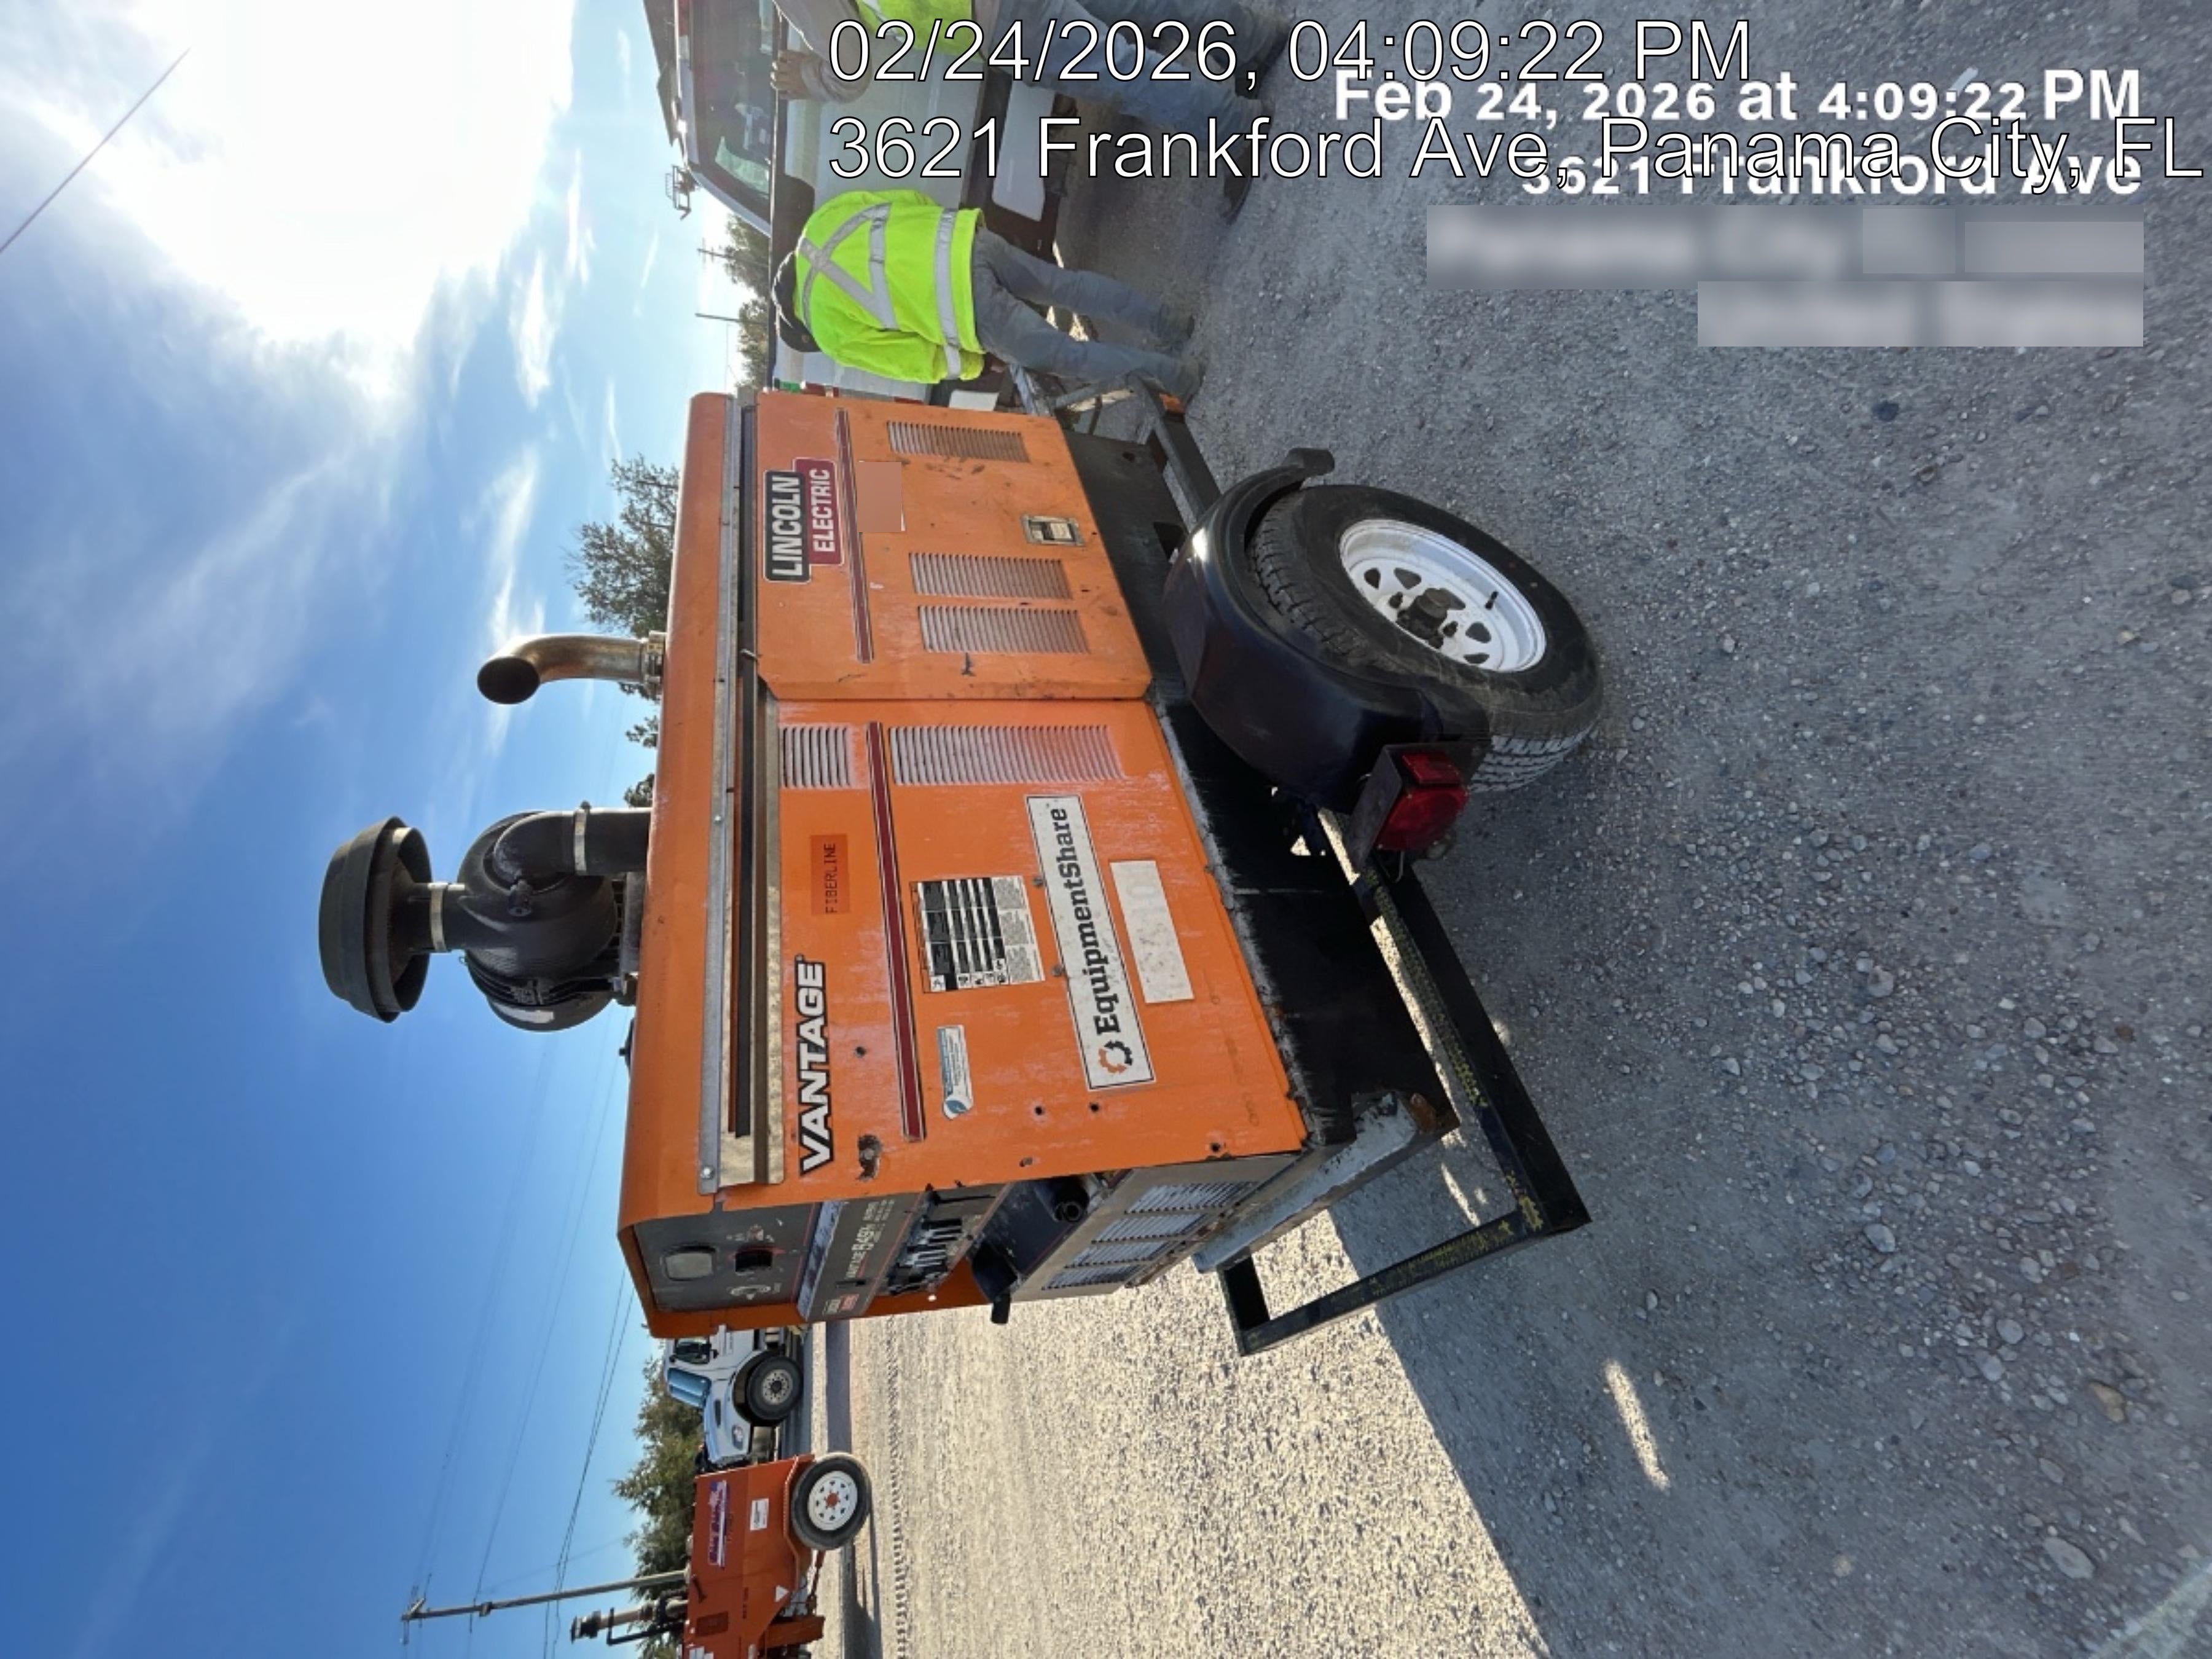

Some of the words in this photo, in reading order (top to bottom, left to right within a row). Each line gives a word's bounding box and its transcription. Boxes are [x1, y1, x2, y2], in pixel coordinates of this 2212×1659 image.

[771, 475, 803, 577] LINCOLN
[809, 469, 836, 553] ELECTRIC
[823, 842, 839, 914] FIBERLINE
[1049, 808, 1121, 1035] EquipmentShare
[796, 961, 832, 1174] VANTAGE
